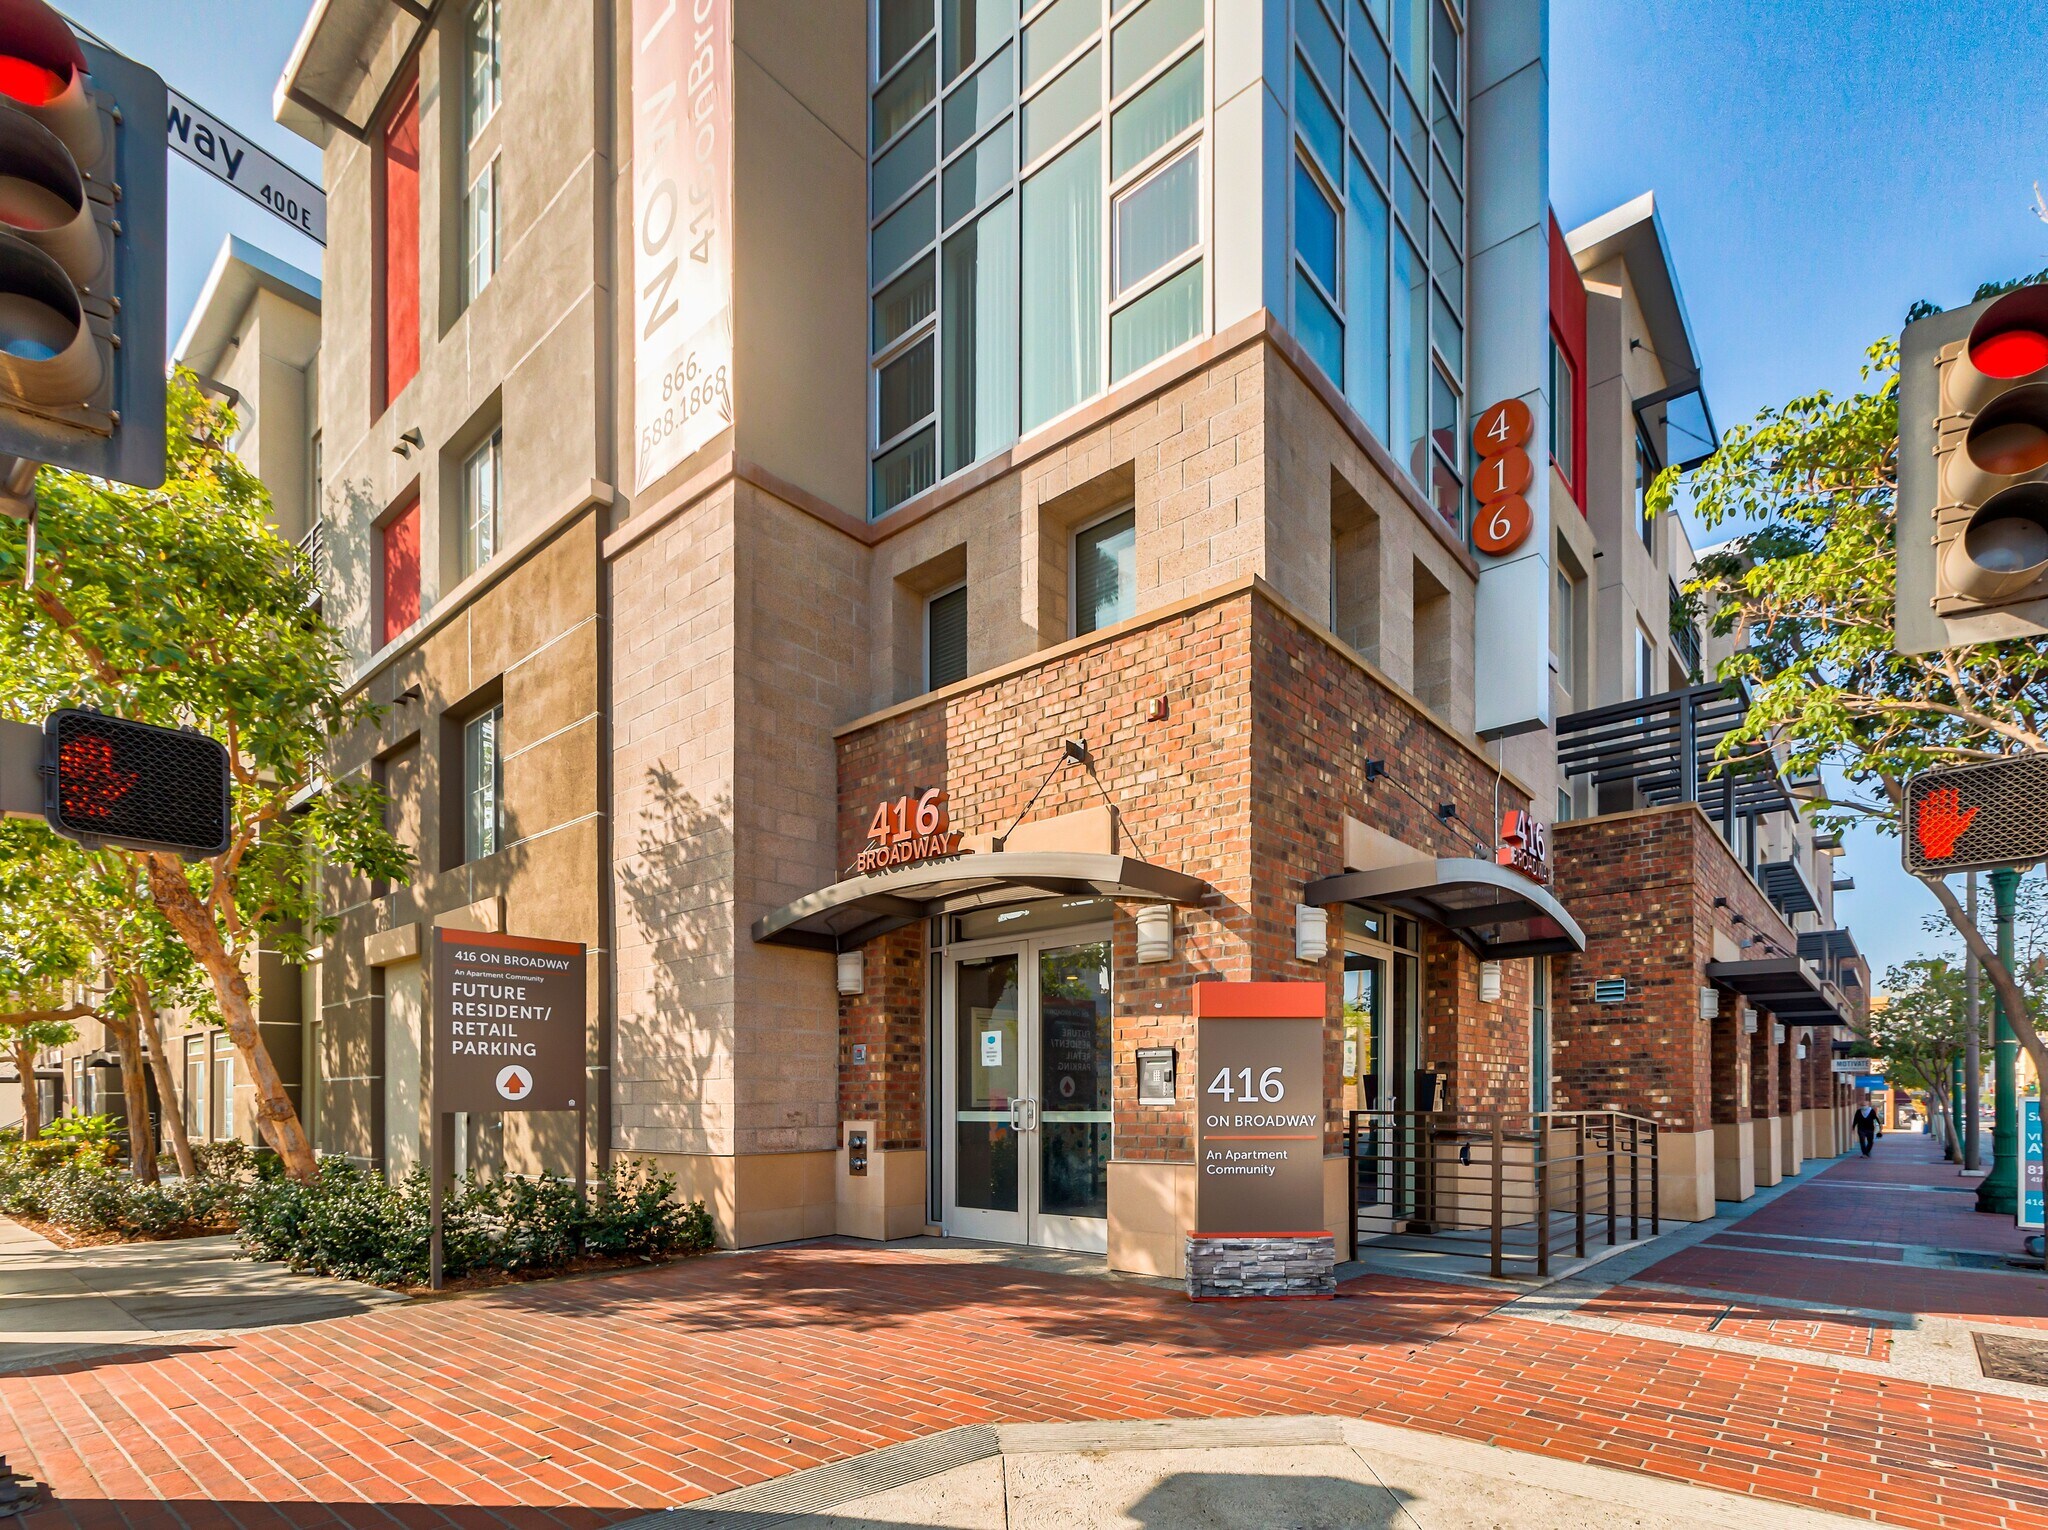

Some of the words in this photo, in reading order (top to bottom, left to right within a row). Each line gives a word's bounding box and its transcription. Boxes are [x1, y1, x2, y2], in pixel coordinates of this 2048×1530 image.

[867, 788, 941, 847] 416
[1516, 810, 1545, 862] 416
[857, 833, 951, 873] BROADWAY
[454, 950, 477, 962] 416
[480, 953, 500, 964] ON
[504, 955, 570, 971] BROADWAY
[466, 970, 504, 980] Apartment
[505, 972, 545, 983] Community
[452, 982, 526, 1001] FUTURE
[452, 1001, 552, 1021] RESIDENT/
[452, 1021, 518, 1038] RETAIL
[452, 1040, 537, 1057] PARKING
[1207, 1066, 1285, 1103] 416
[1206, 1115, 1230, 1127] ON
[1235, 1115, 1317, 1127] BROADWAY
[1206, 1150, 1222, 1160] An
[1225, 1150, 1288, 1162] Apartment
[1206, 1164, 1276, 1177] Community
